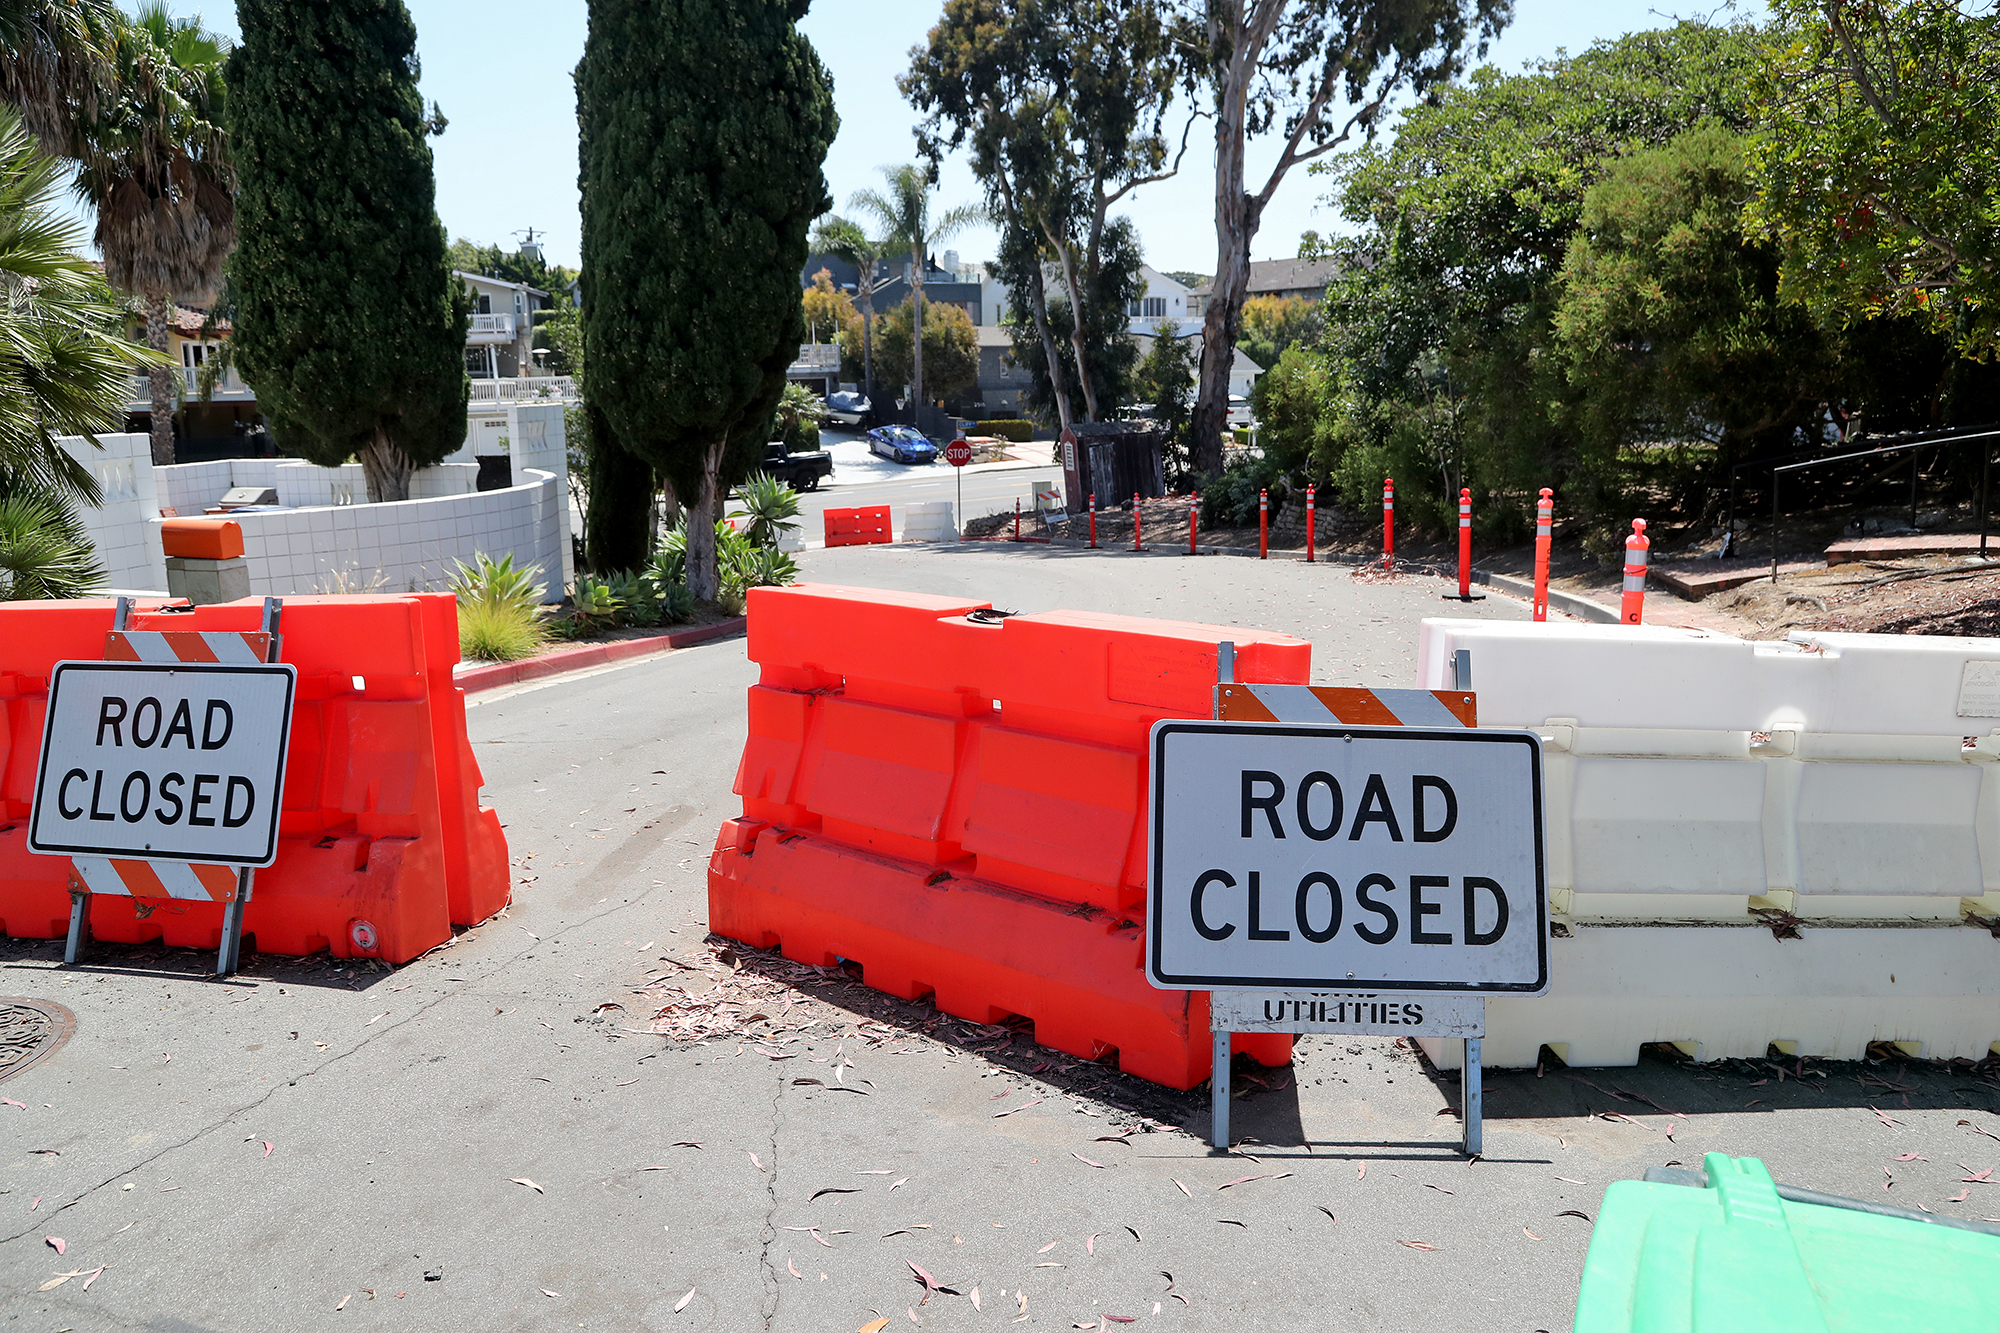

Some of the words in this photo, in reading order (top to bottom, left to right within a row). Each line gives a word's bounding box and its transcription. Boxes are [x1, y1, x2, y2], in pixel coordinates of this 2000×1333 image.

[947, 448, 970, 459] STOP
[96, 696, 233, 750] ROAD
[58, 768, 255, 828] CLOSED
[1240, 770, 1458, 843] ROAD
[1190, 869, 1509, 945] CLOSED
[1264, 1000, 1424, 1025] UTILITIES
